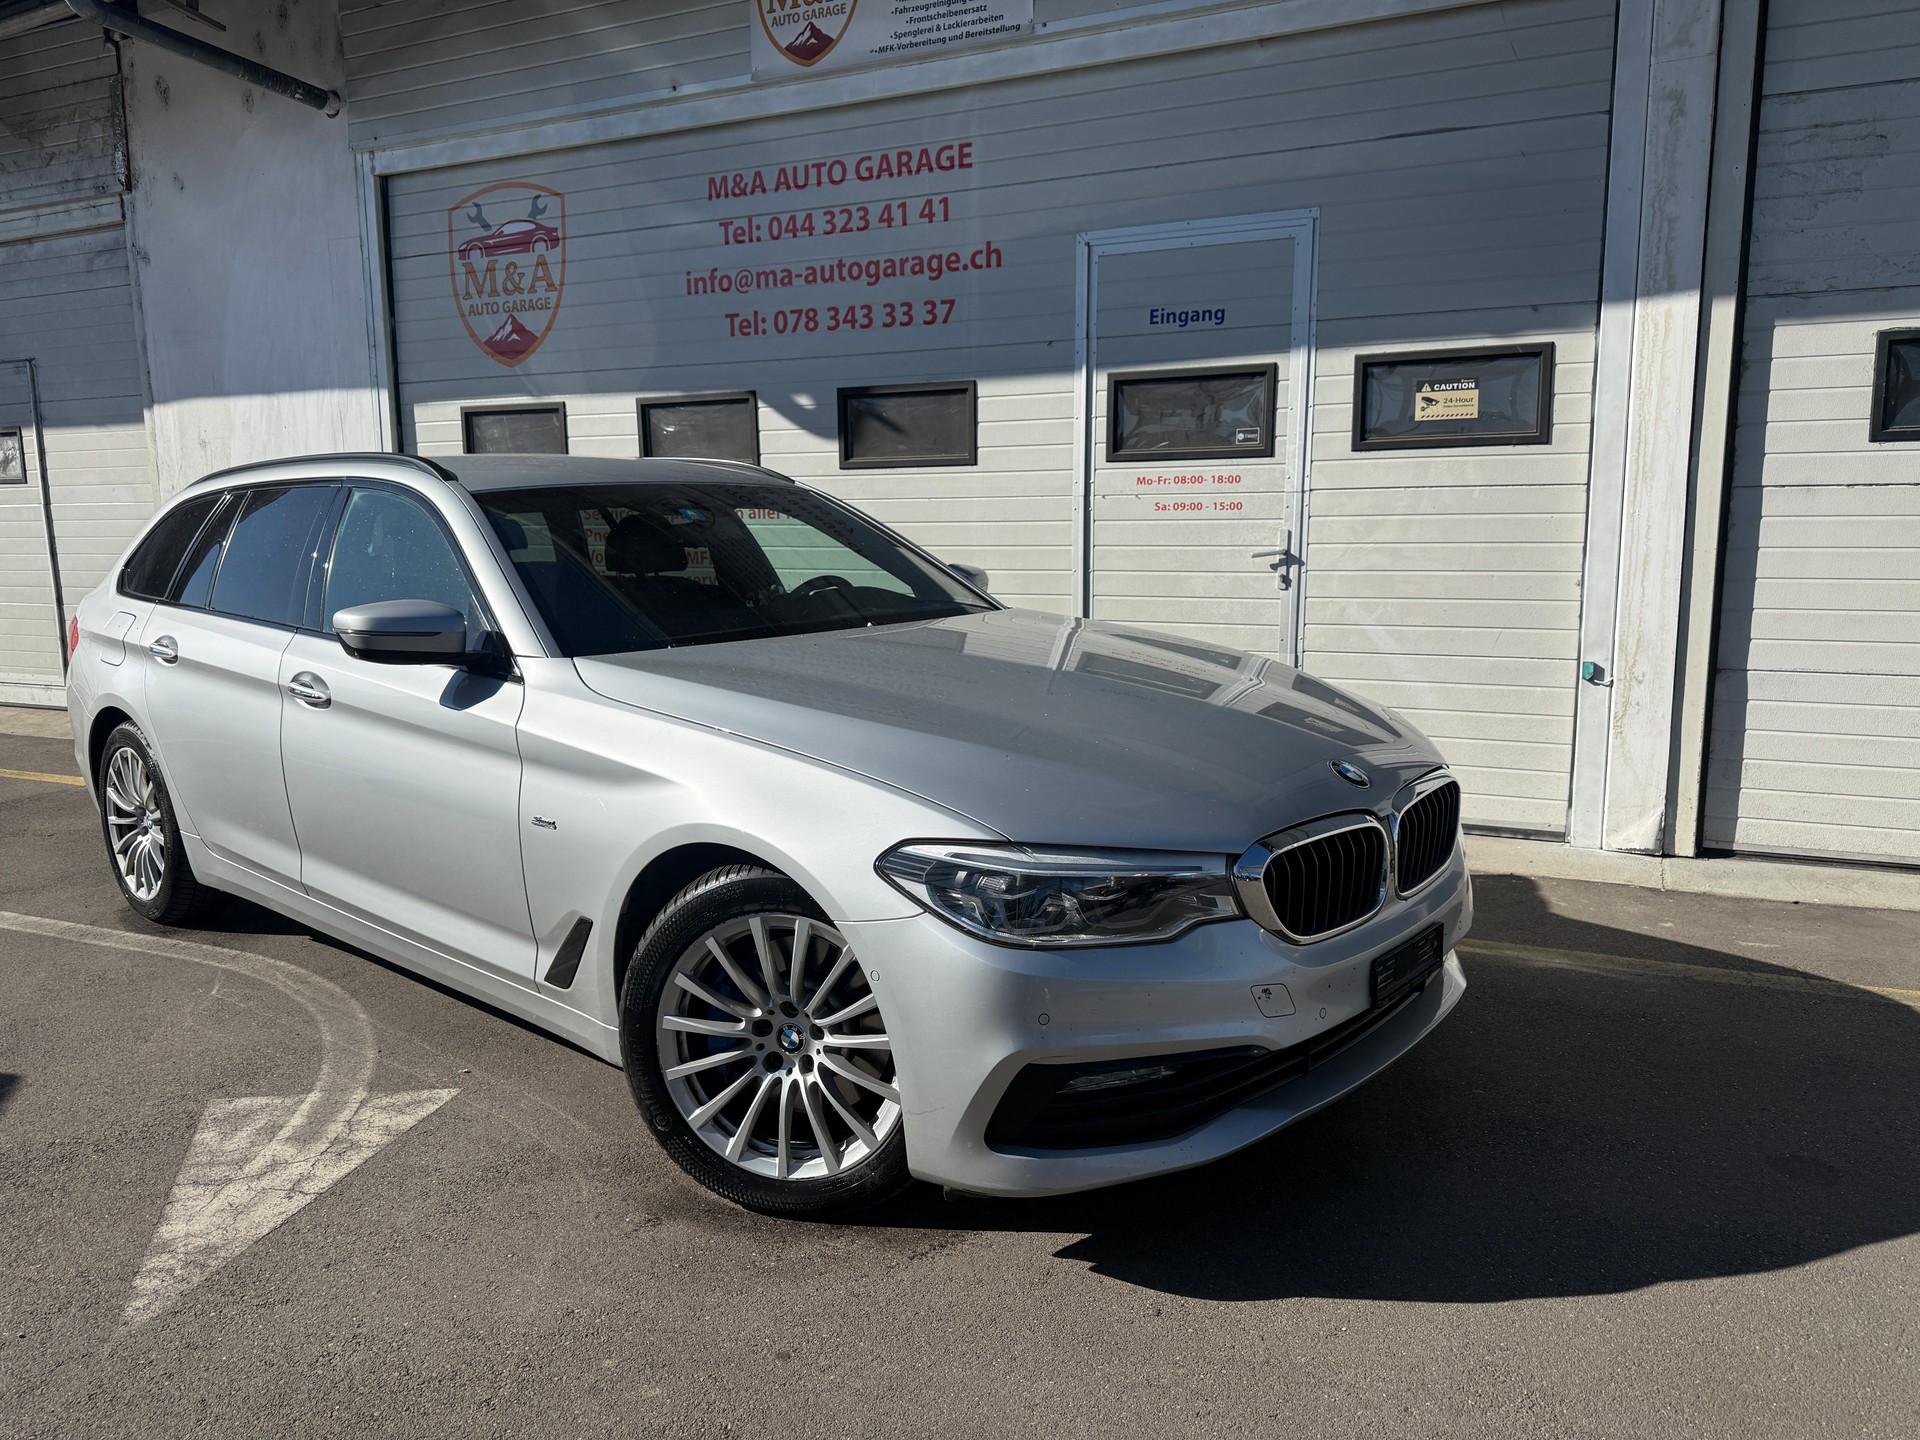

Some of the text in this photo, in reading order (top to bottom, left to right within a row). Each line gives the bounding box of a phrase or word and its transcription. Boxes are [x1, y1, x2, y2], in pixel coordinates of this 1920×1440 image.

[771, 12, 800, 28] AUTO
[802, 3, 847, 21] GARAGE
[909, 4, 987, 24] Frontscheibenersatz
[878, 23, 1021, 54] MFK-Vorbereitung und Bereitstellung
[893, 24, 934, 41] Spenglerei
[943, 14, 1004, 31] Lackierarbeiten
[708, 142, 974, 200] M&A AUTO GARAGE
[720, 196, 951, 245] Tel: 044 323 41 41
[462, 254, 558, 300] M&A
[685, 240, 1003, 297] info@ma-autogarage.ch
[468, 296, 552, 317] AUTO GARAGE
[725, 298, 957, 337] Tel: 078 343 33 37
[1149, 307, 1226, 327] Eingang
[1433, 382, 1475, 391] CAUTION
[1135, 475, 1171, 486] Mo-Fr:
[1210, 475, 1241, 485] 18:00
[1154, 501, 1171, 512] Sa:
[1172, 501, 1203, 512] 09:00
[1213, 501, 1244, 512] 15:00
